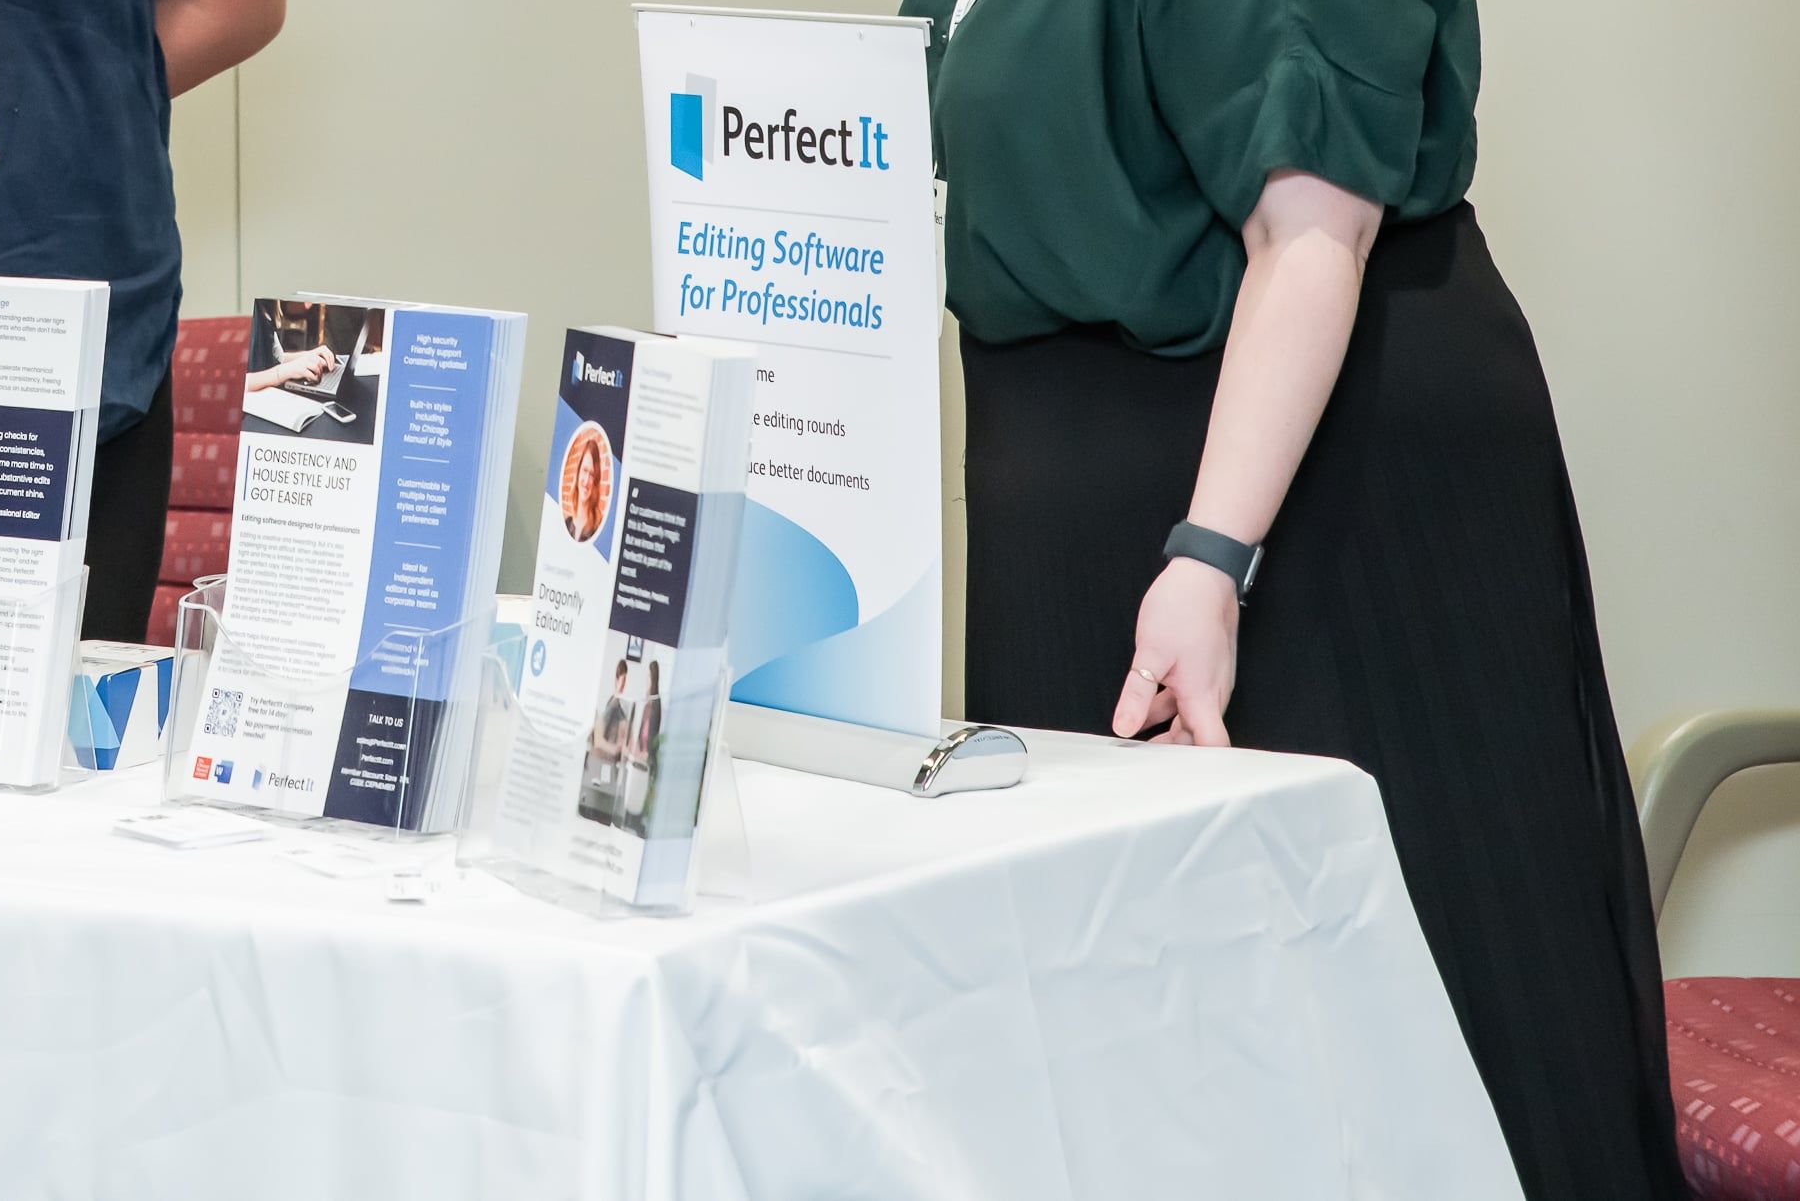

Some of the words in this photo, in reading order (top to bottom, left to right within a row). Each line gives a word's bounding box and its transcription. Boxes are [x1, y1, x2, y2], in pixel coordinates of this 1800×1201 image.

[723, 106, 889, 170] PerfectIt
[678, 221, 765, 271] Editing
[772, 230, 885, 276] Software
[680, 274, 715, 316] for
[722, 279, 883, 330] Professionals
[411, 345, 435, 357] Friendly
[436, 349, 462, 358] support
[404, 356, 438, 369] Constantly
[439, 359, 468, 370] updated
[585, 362, 623, 388] PerfectIt
[756, 369, 775, 382] me
[410, 400, 432, 410] Built-in
[434, 402, 452, 412] styles
[409, 423, 420, 431] The
[422, 423, 449, 436] Chicago
[764, 411, 804, 436] editing
[808, 419, 845, 437] rounds
[4, 431, 27, 440] checks
[28, 433, 38, 441] for
[404, 434, 428, 444] Manual
[429, 436, 436, 445] of
[436, 437, 452, 448] Style
[11, 460, 28, 468] more
[30, 461, 45, 470] time
[254, 448, 332, 469] CONSISTENCY
[334, 457, 357, 472] AND
[34, 477, 50, 485] edits
[252, 467, 290, 484] HOUSE
[293, 472, 322, 488] STYLE
[325, 476, 351, 490] JUST
[769, 459, 804, 480] better
[807, 465, 870, 490] documents
[250, 487, 275, 502] GOT
[278, 490, 313, 506] EASIER
[400, 490, 425, 502] multiple
[426, 492, 446, 503] house
[22, 511, 40, 519] Editor
[396, 502, 414, 512] styles
[416, 504, 428, 513] and
[430, 505, 447, 515] client
[242, 514, 262, 524] Editing
[262, 517, 286, 526] software
[288, 520, 314, 530] designed
[323, 524, 360, 534] professionals
[539, 583, 585, 616] Dragonfly
[536, 610, 574, 636] Editorial
[245, 720, 253, 728] No
[253, 722, 279, 732] payment
[280, 725, 313, 736] information
[368, 714, 384, 724] TALK
[385, 716, 394, 726] TO
[394, 718, 404, 728] US
[268, 773, 314, 792] PerfectIt
